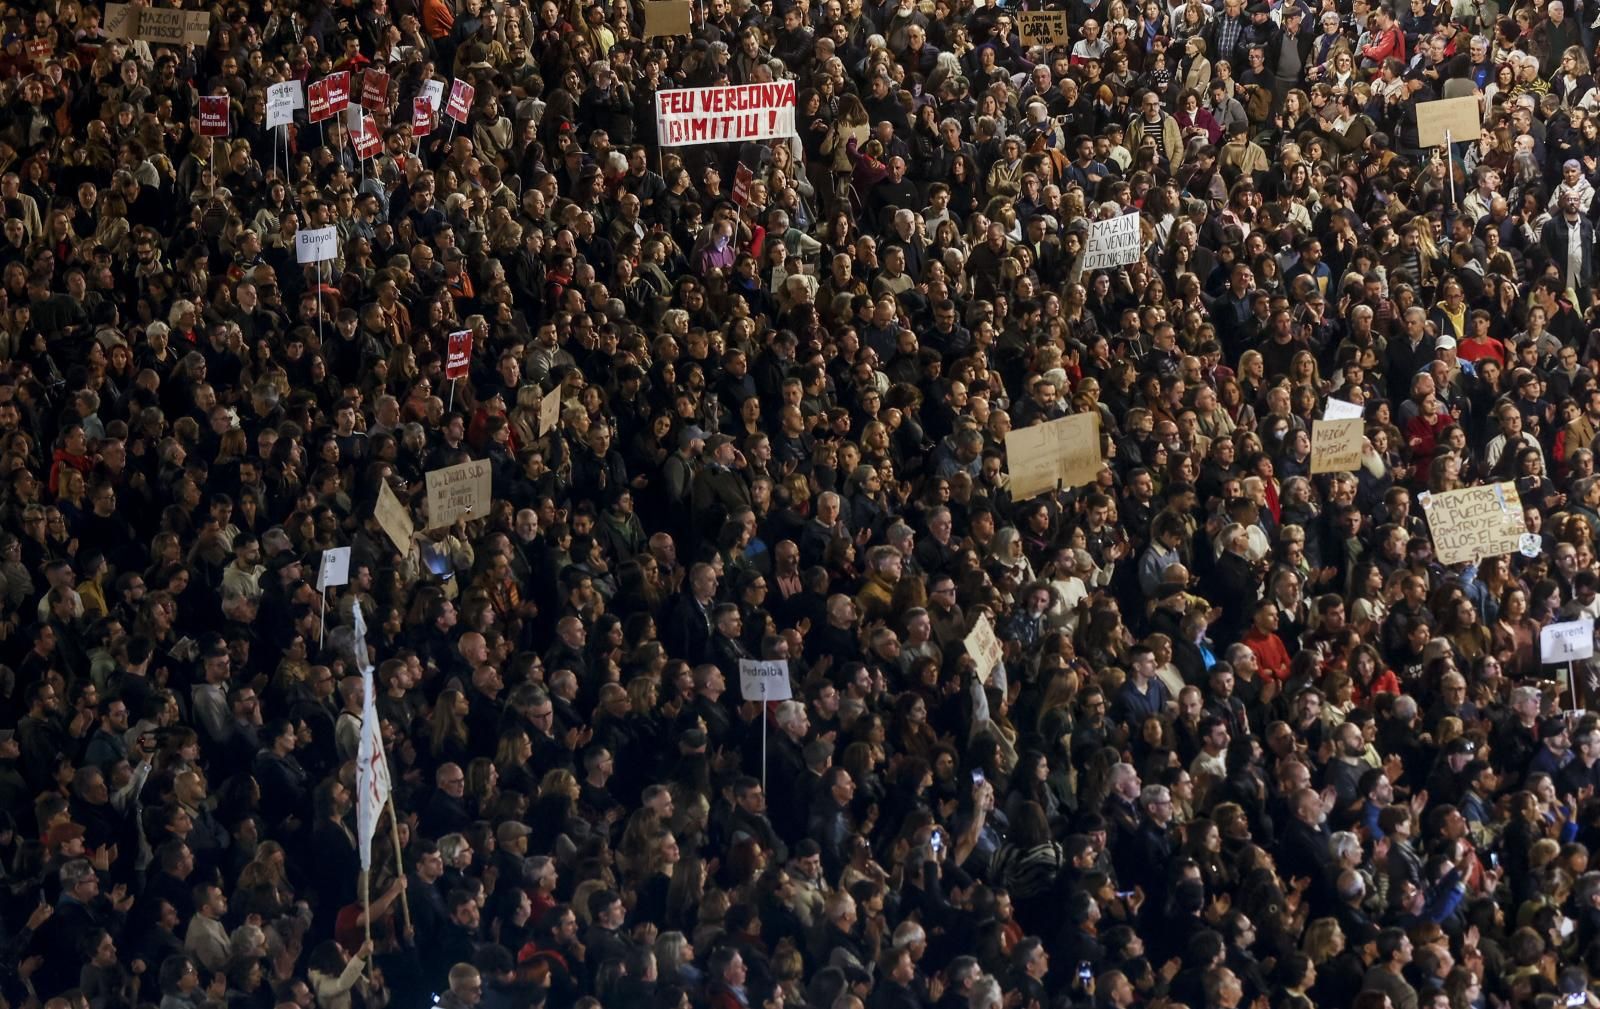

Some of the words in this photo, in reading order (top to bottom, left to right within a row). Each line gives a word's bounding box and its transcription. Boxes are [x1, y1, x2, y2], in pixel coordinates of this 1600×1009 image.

[1023, 22, 1050, 37] CARA
[1036, 36, 1053, 45] VIDA
[660, 91, 694, 115] FEU
[700, 82, 796, 113] VERGONYA
[201, 112, 220, 120] Mazón
[302, 231, 332, 245] Bunyol
[1088, 239, 1101, 252] EL
[1085, 255, 1096, 268] LO
[468, 465, 483, 479] SUD
[1431, 488, 1495, 511] MIENTRAS
[1428, 511, 1446, 527] EL
[1449, 501, 1501, 524] PUEBLO
[1437, 532, 1476, 550] ELLOS
[1478, 530, 1498, 544] EL
[1551, 626, 1584, 639] Torrent
[759, 682, 766, 693] 3
